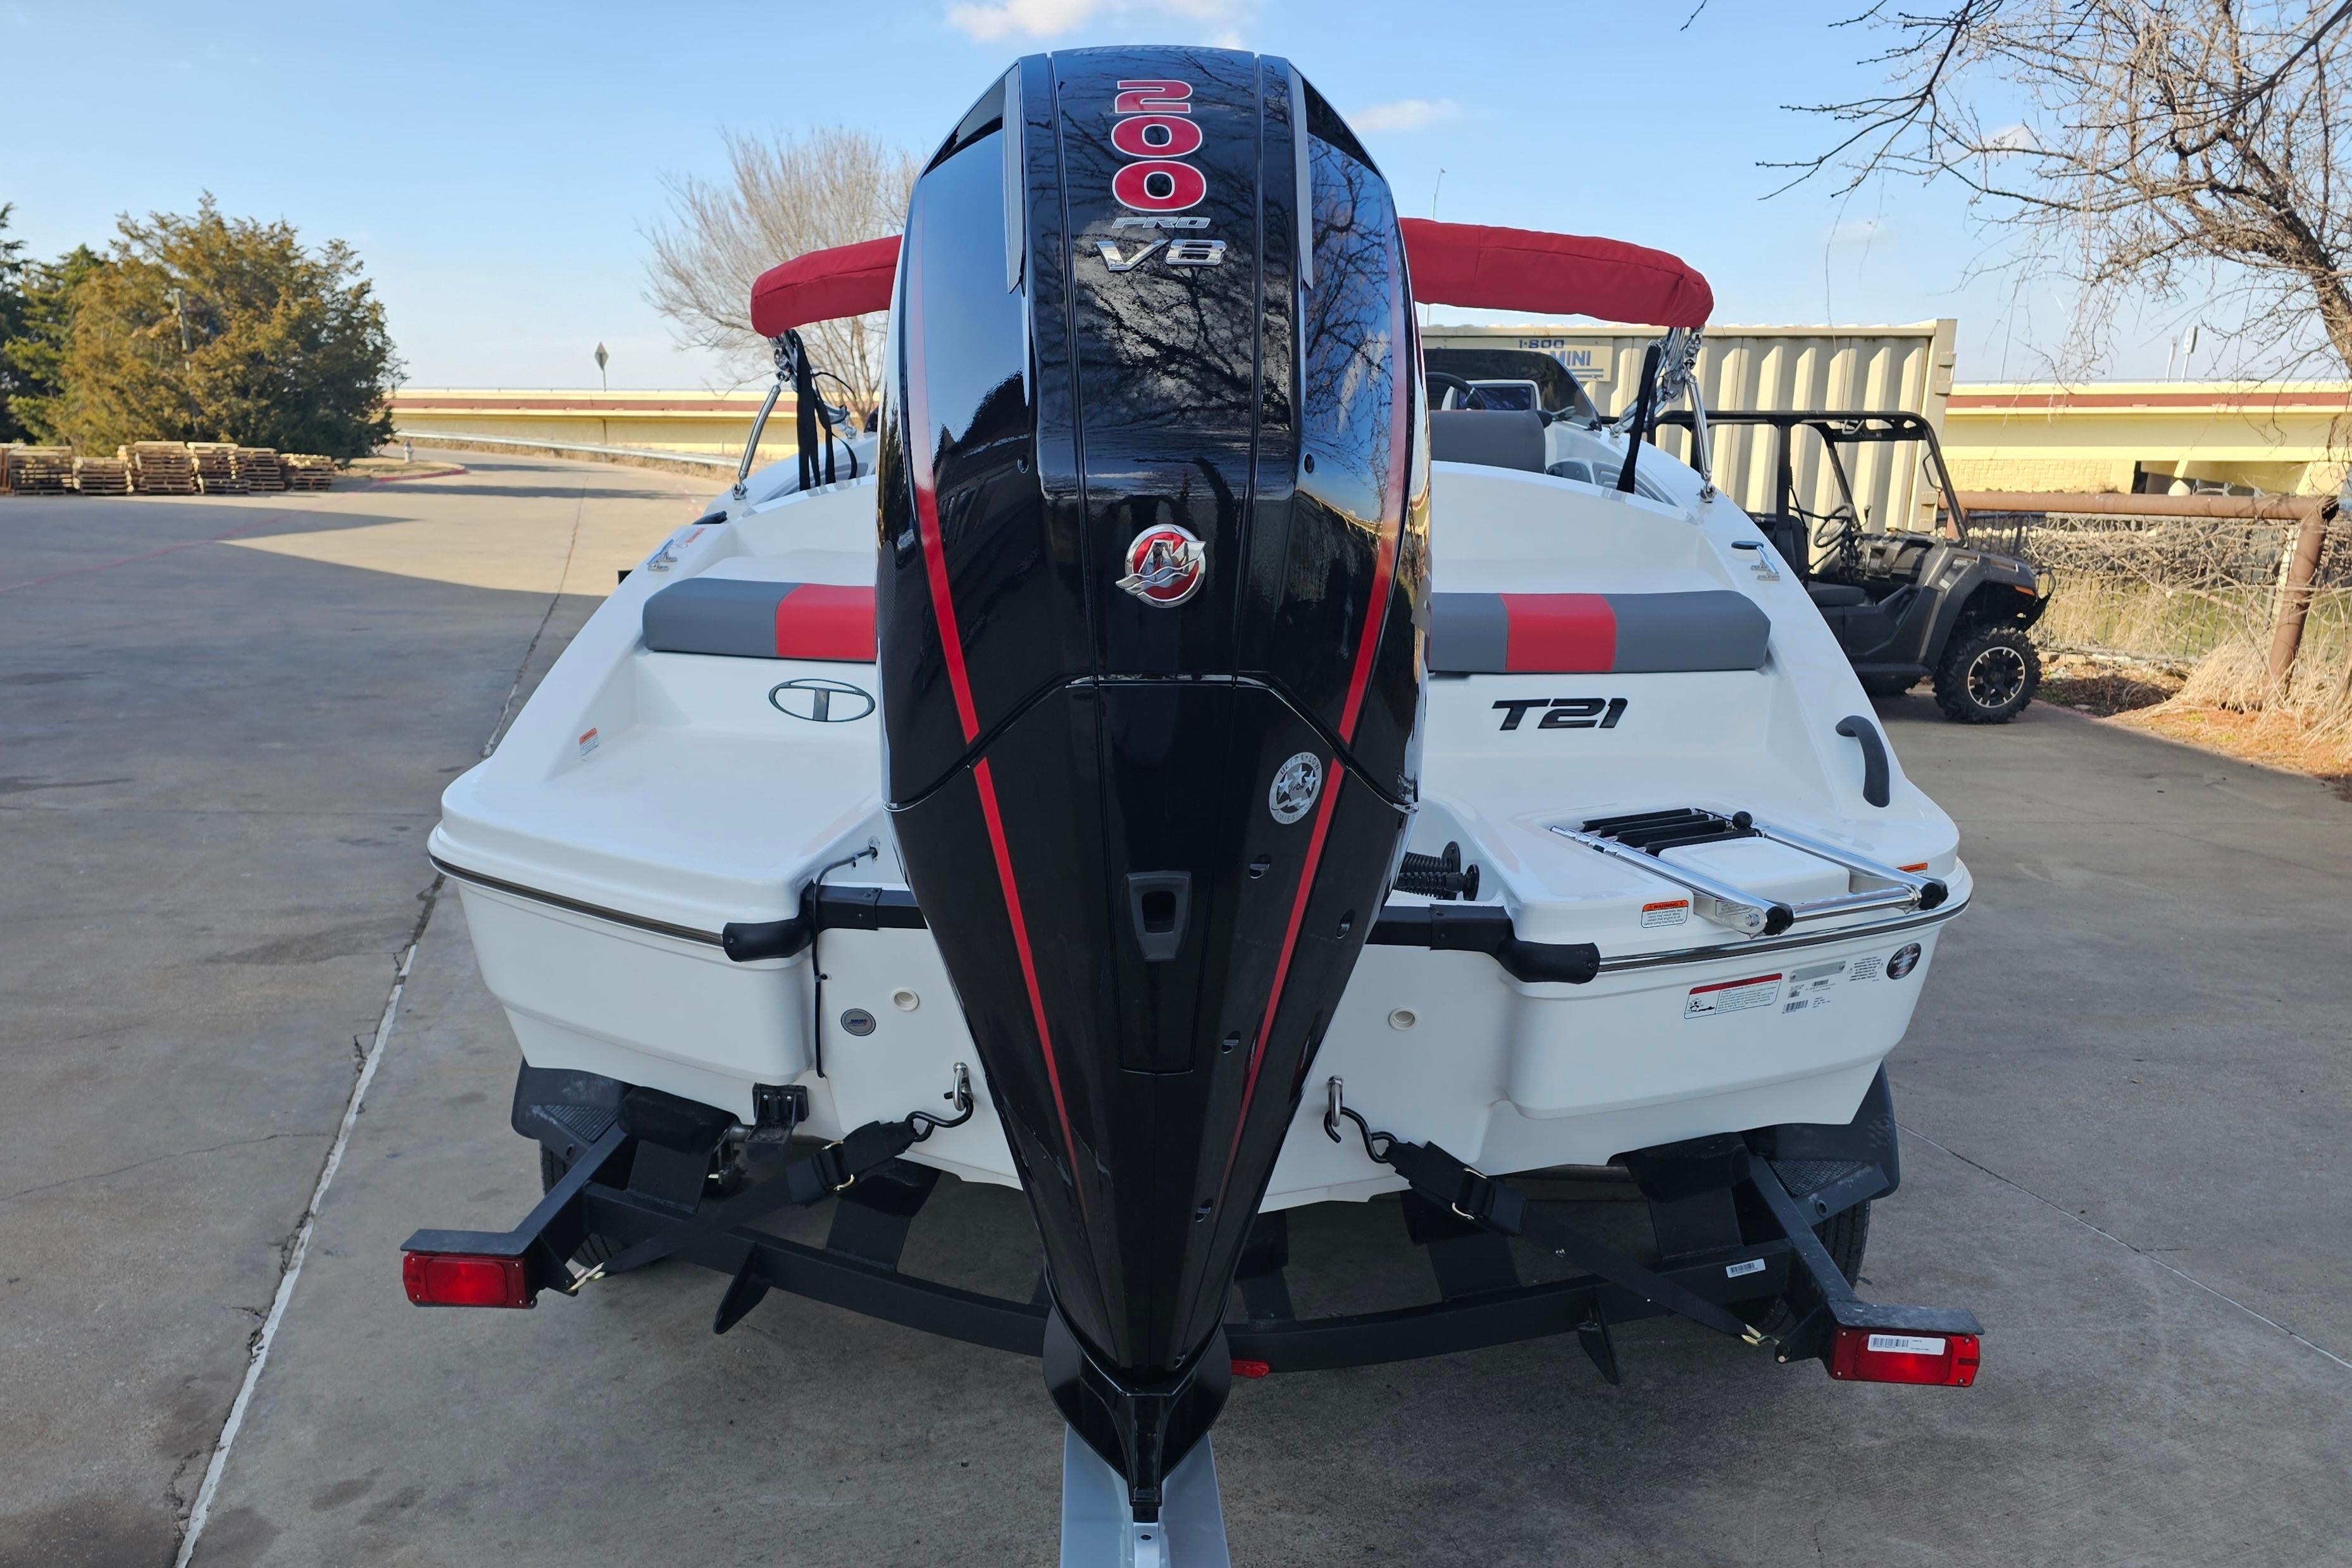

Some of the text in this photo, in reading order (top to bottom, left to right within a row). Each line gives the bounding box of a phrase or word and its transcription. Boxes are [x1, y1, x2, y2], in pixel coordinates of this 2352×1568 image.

[1111, 80, 1207, 212] 200
[1111, 216, 1211, 229] PRO
[1095, 239, 1228, 273] V8
[1491, 697, 1629, 731] T21
